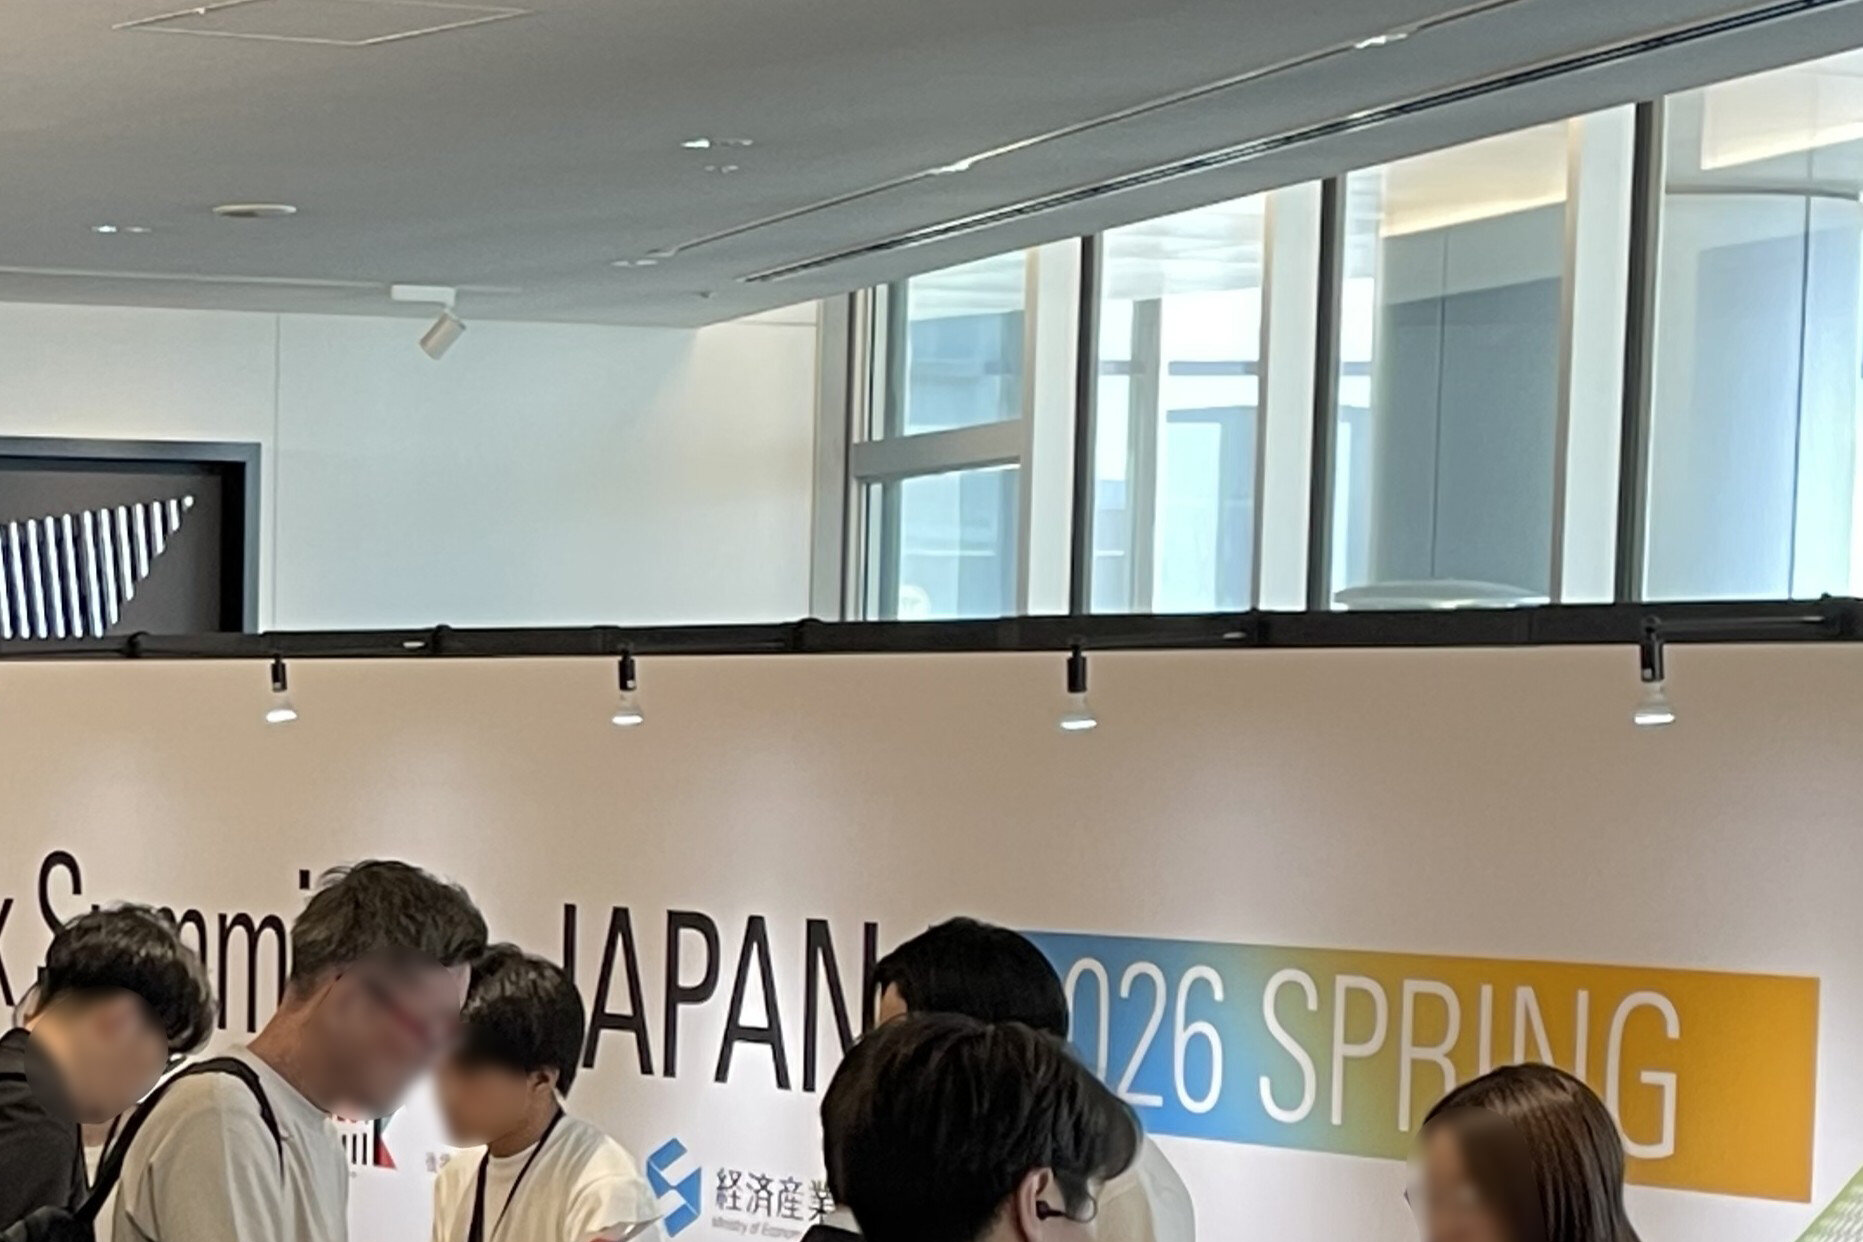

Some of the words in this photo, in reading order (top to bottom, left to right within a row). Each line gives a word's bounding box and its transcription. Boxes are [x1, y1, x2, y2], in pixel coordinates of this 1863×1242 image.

[1064, 957, 1225, 1115] 026
[1259, 968, 1681, 1160] SPRING
[715, 1167, 835, 1225] 経済産業
